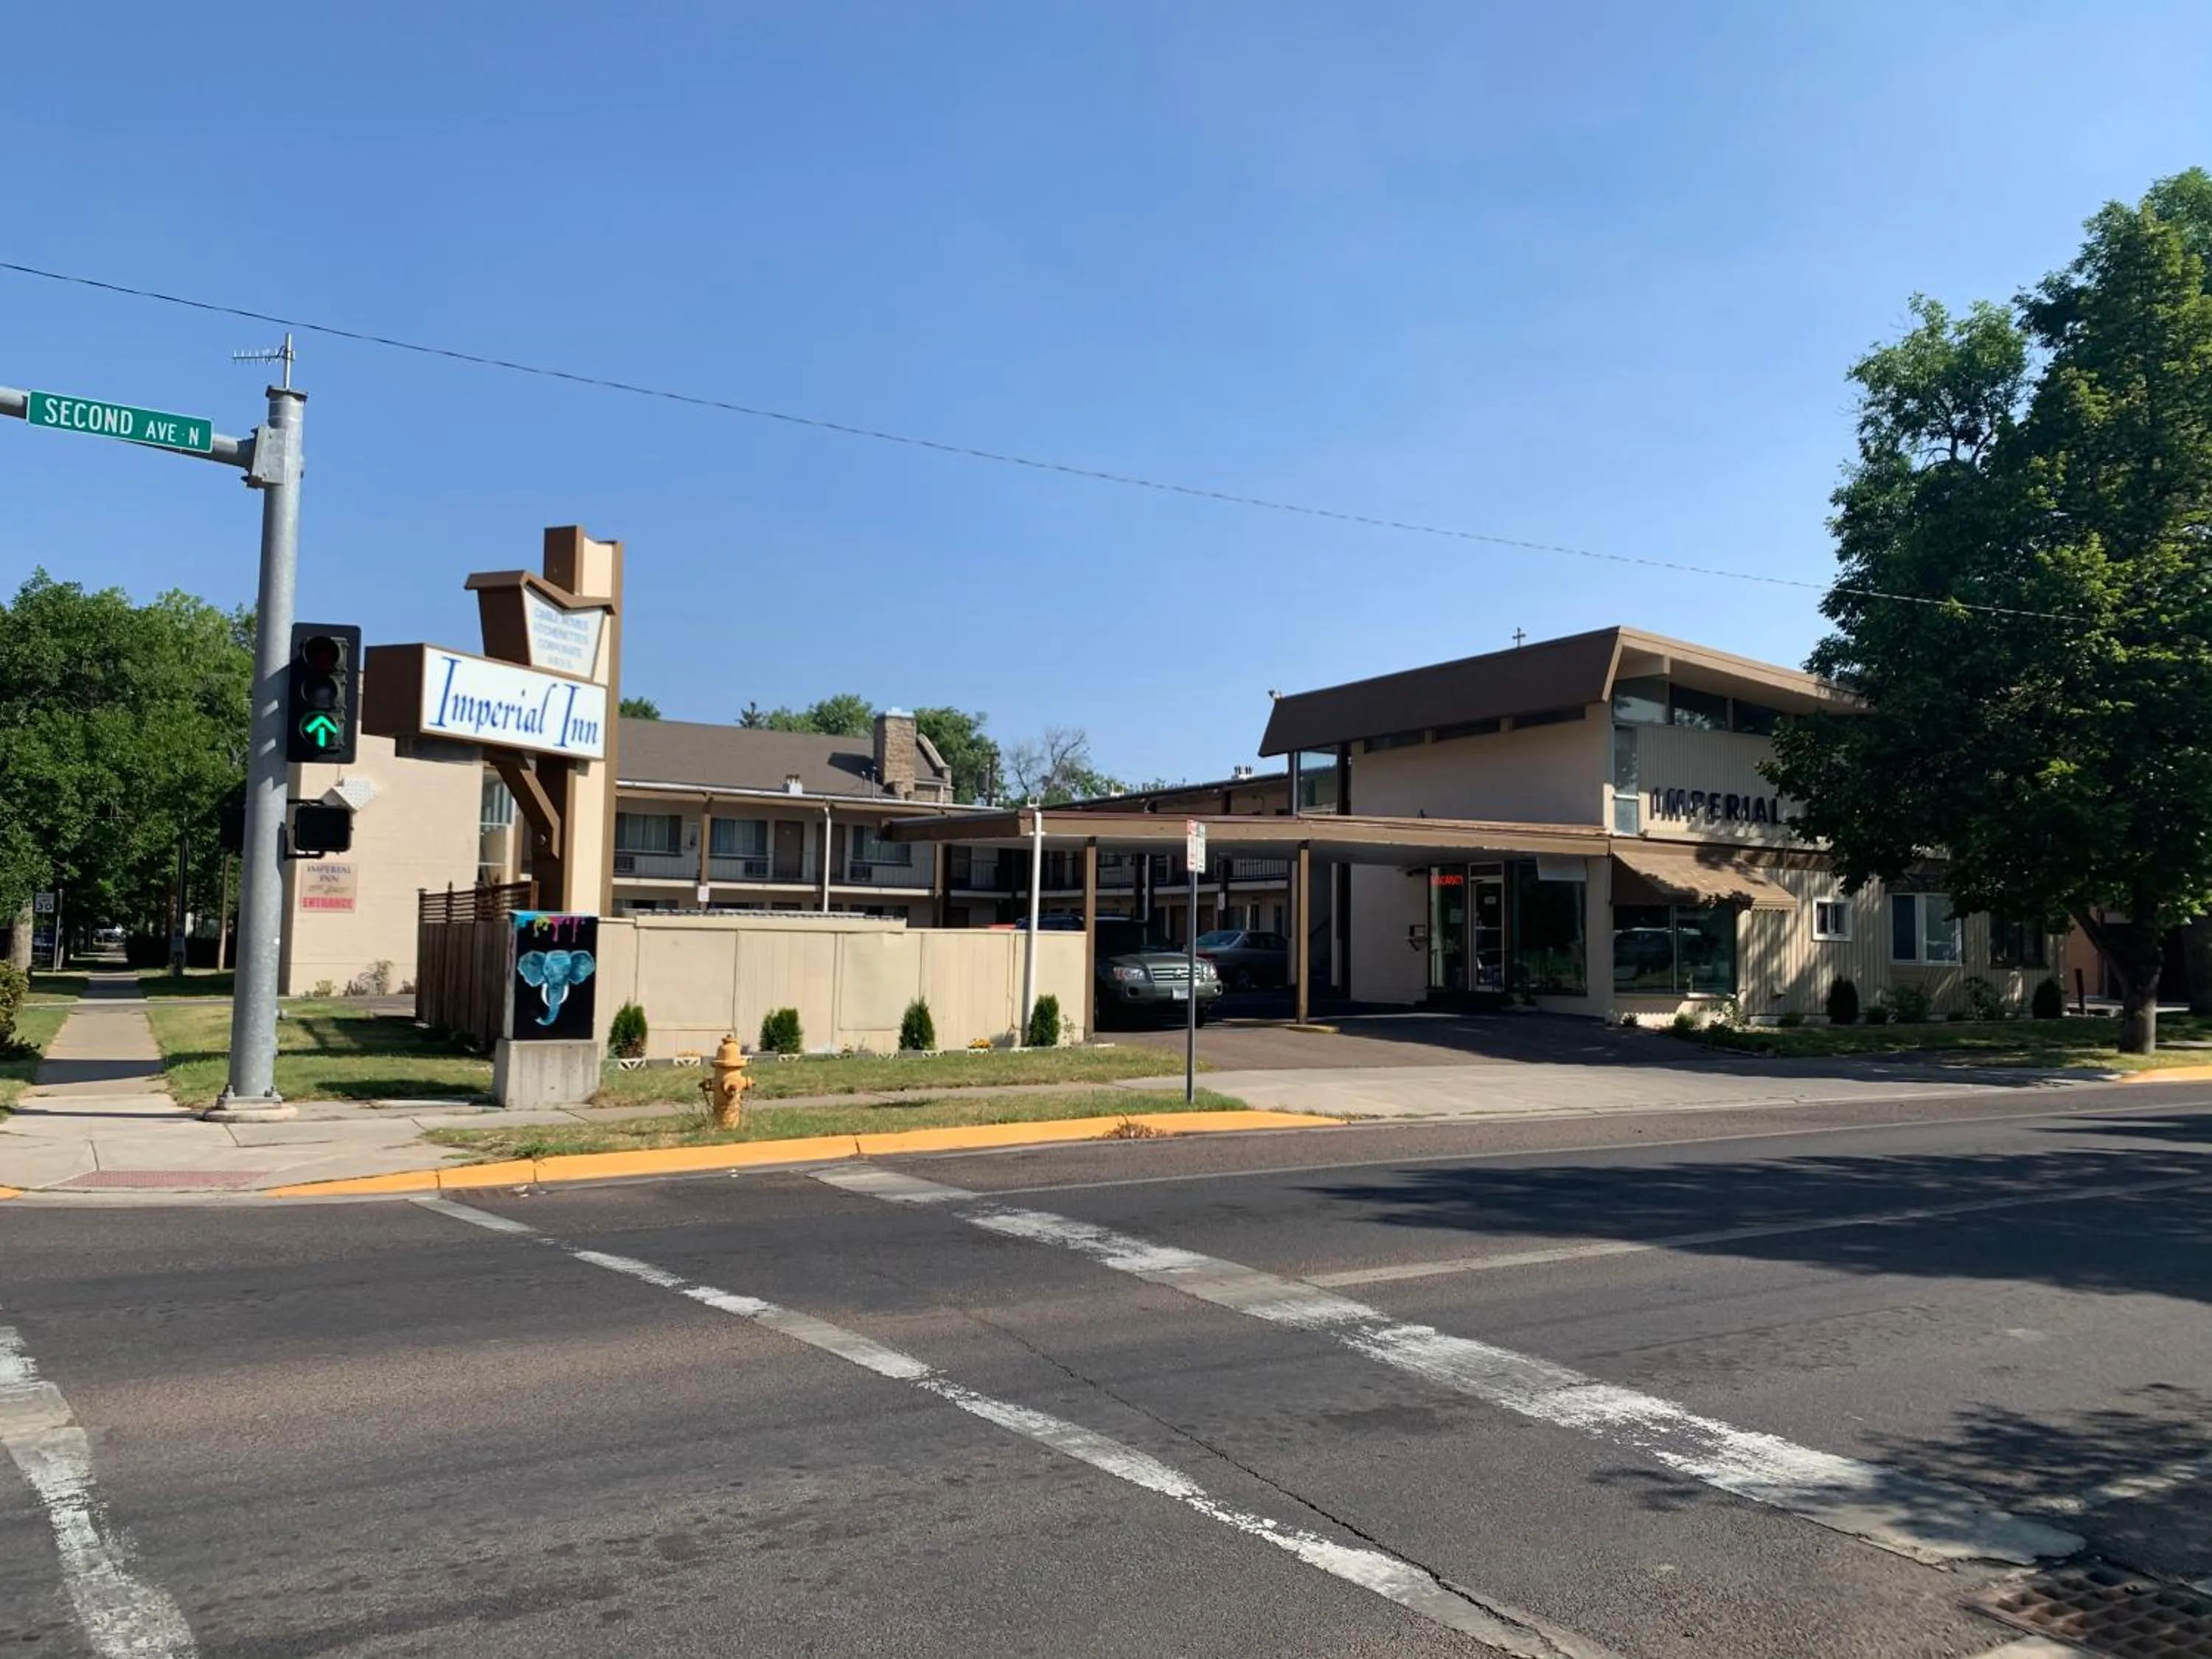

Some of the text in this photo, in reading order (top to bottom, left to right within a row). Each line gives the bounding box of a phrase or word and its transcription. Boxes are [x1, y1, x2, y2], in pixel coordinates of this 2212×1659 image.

[44, 397, 200, 446] SECOND AVE N
[428, 656, 599, 748] Imperial Inn
[1651, 787, 1781, 825] IMPERIAL
[307, 865, 351, 874] IMPERIAL
[319, 874, 339, 883] INN
[35, 902, 52, 911] 30
[303, 897, 354, 909] ENTRANCE
